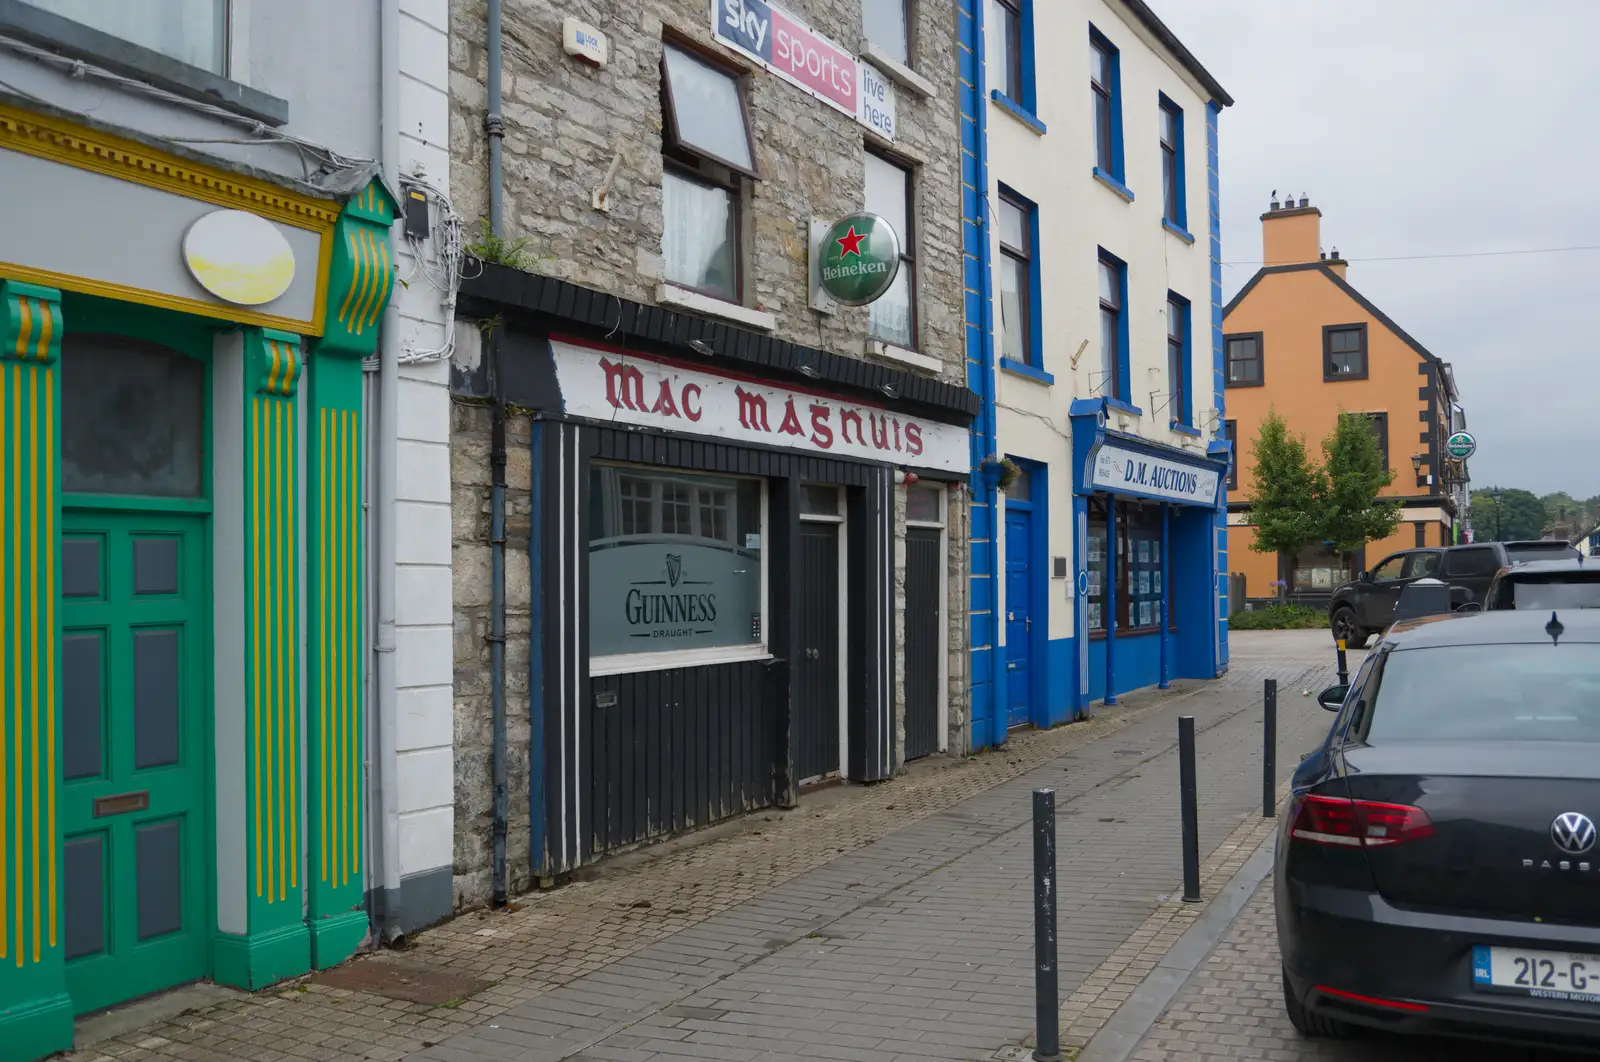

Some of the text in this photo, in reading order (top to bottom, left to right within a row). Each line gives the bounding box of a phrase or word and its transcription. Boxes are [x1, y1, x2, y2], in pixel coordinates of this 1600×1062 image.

[725, 0, 851, 97] sky sports
[863, 68, 885, 102] live
[864, 99, 892, 134] here
[823, 261, 887, 281] Heineken
[598, 356, 703, 422] MAC
[1124, 459, 1197, 495] D.M. AUCTIONS
[625, 588, 717, 625] GUINNESS
[653, 628, 693, 638] DRAUGHT
[1523, 859, 1600, 872] PASS
[1475, 967, 1490, 978] IRL
[1530, 989, 1569, 1000] WESTERN
